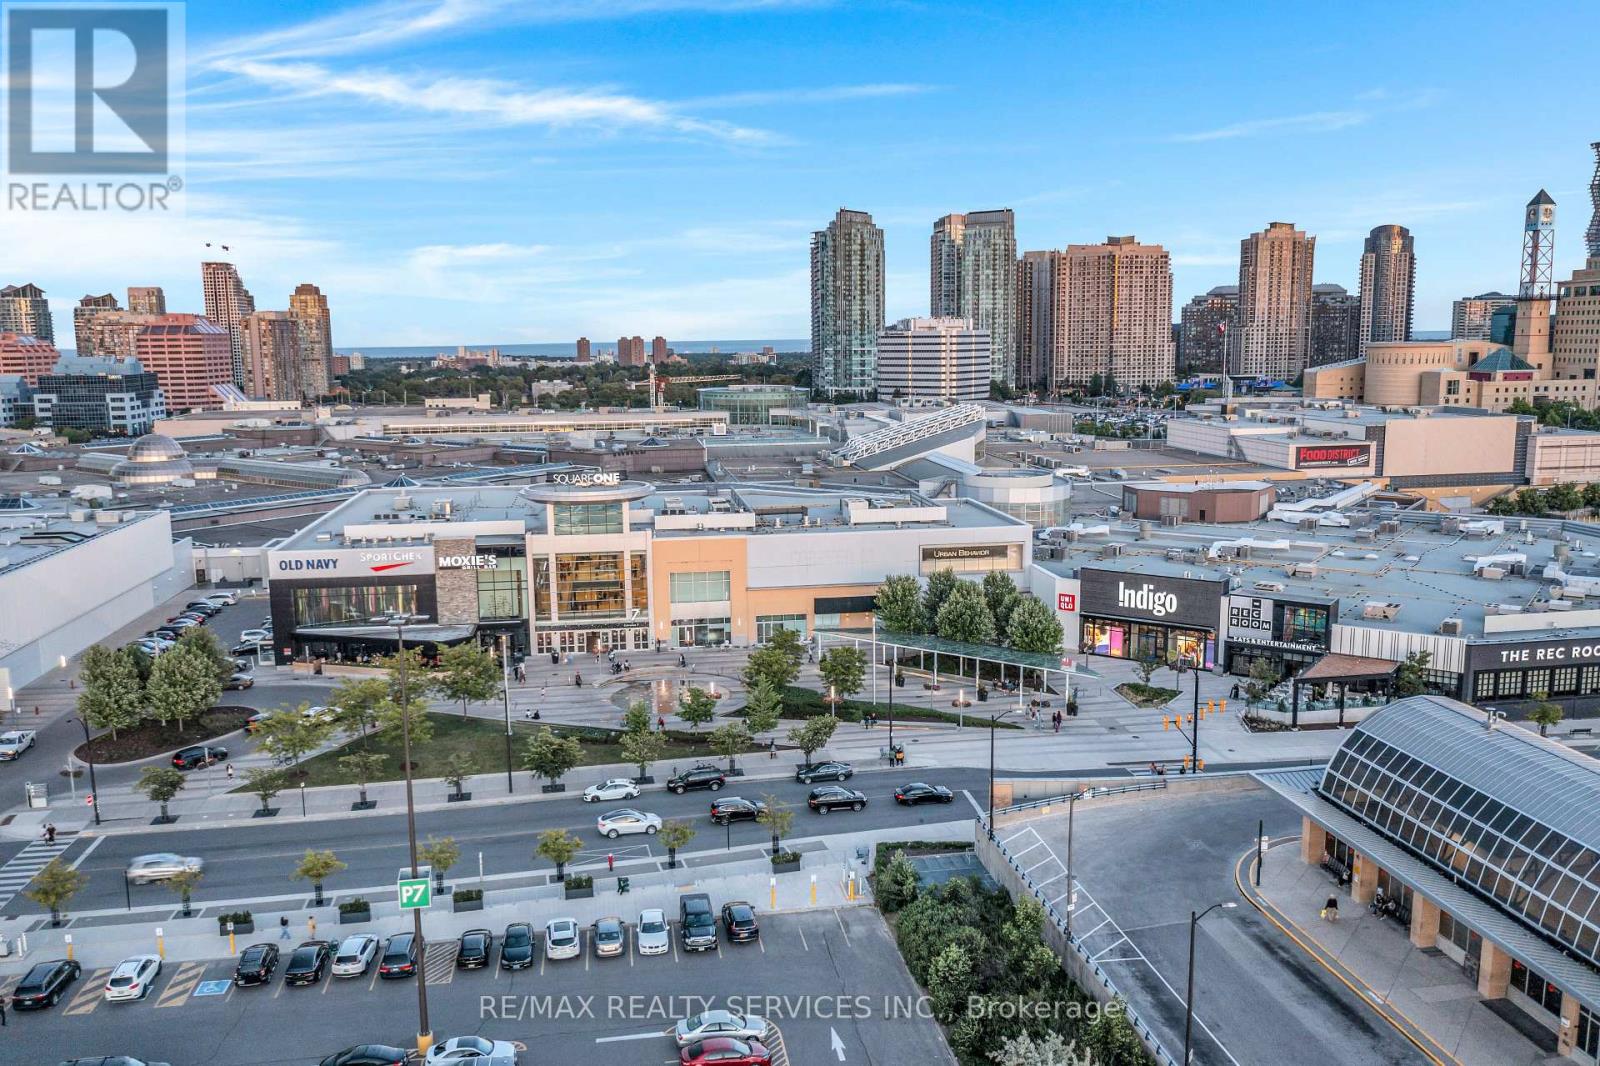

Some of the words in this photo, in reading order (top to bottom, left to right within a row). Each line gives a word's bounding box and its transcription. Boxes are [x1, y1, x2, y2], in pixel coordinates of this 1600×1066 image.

[279, 559, 304, 571] OLD
[306, 558, 339, 570] NAVY
[439, 554, 497, 566] MOXIE'S
[631, 608, 641, 621] 7
[1231, 607, 1261, 618] REC
[1231, 619, 1271, 631] ROOM
[1257, 639, 1316, 652] ENTERTAINMENT
[1501, 649, 1530, 662] THE
[1536, 646, 1566, 660] REC
[402, 884, 426, 903] P7
